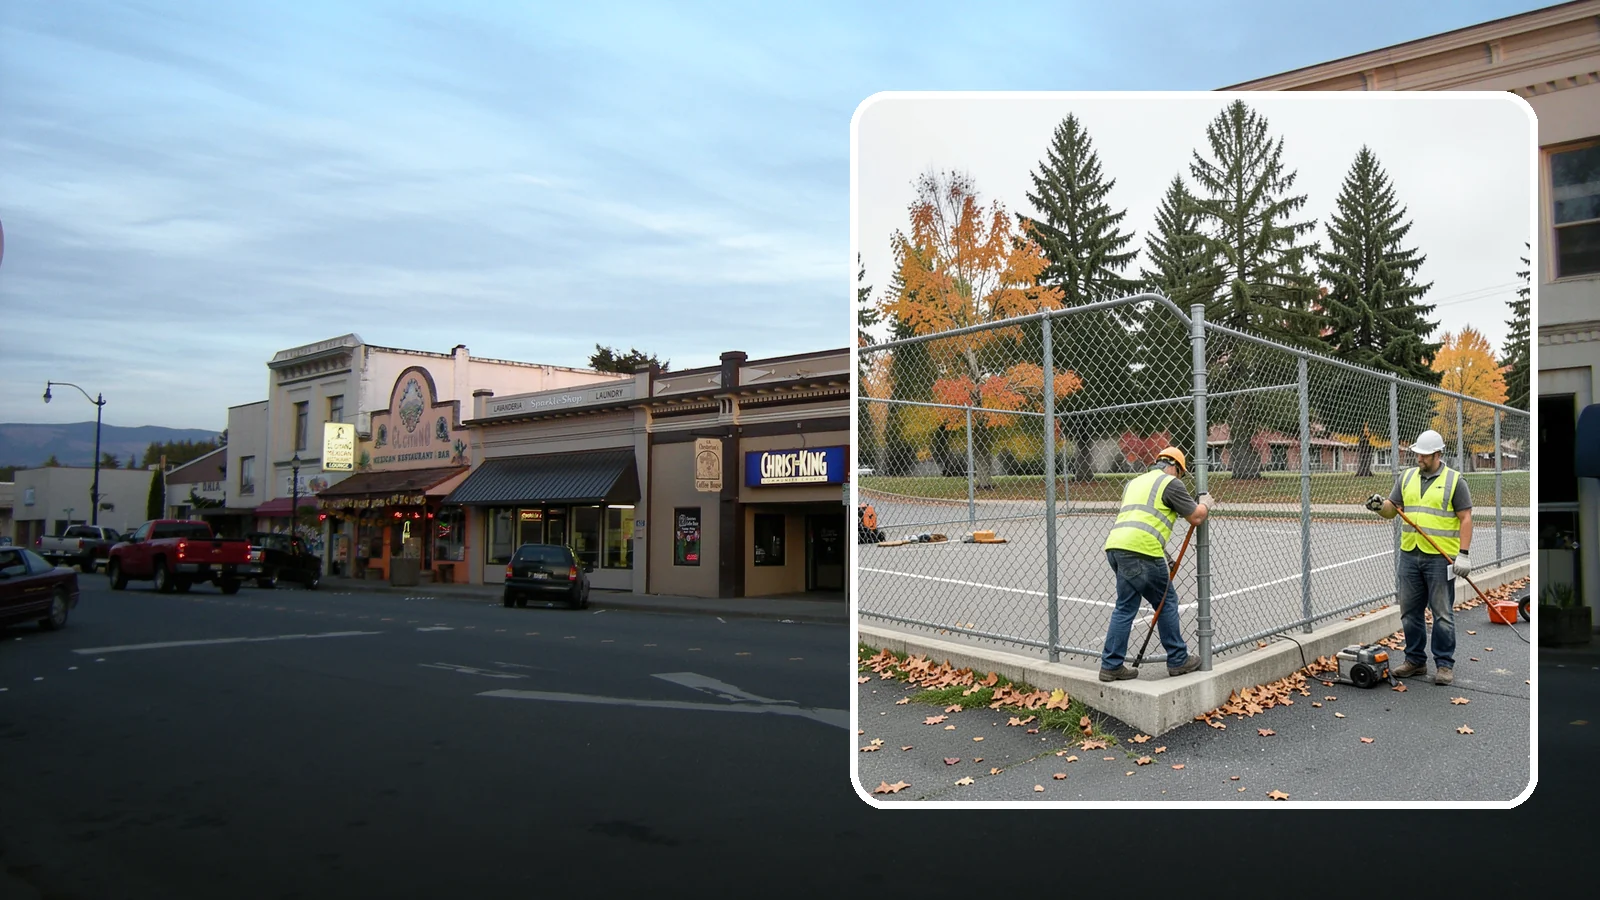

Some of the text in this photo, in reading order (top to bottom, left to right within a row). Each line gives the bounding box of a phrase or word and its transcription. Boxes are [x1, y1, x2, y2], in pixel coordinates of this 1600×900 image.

[493, 389, 623, 412] LAVANDERIA Sparkle Shop LAUNDRY
[374, 450, 450, 464] MEXICAN RESTAURANT BAR
[760, 450, 827, 478] CHRIST KING
